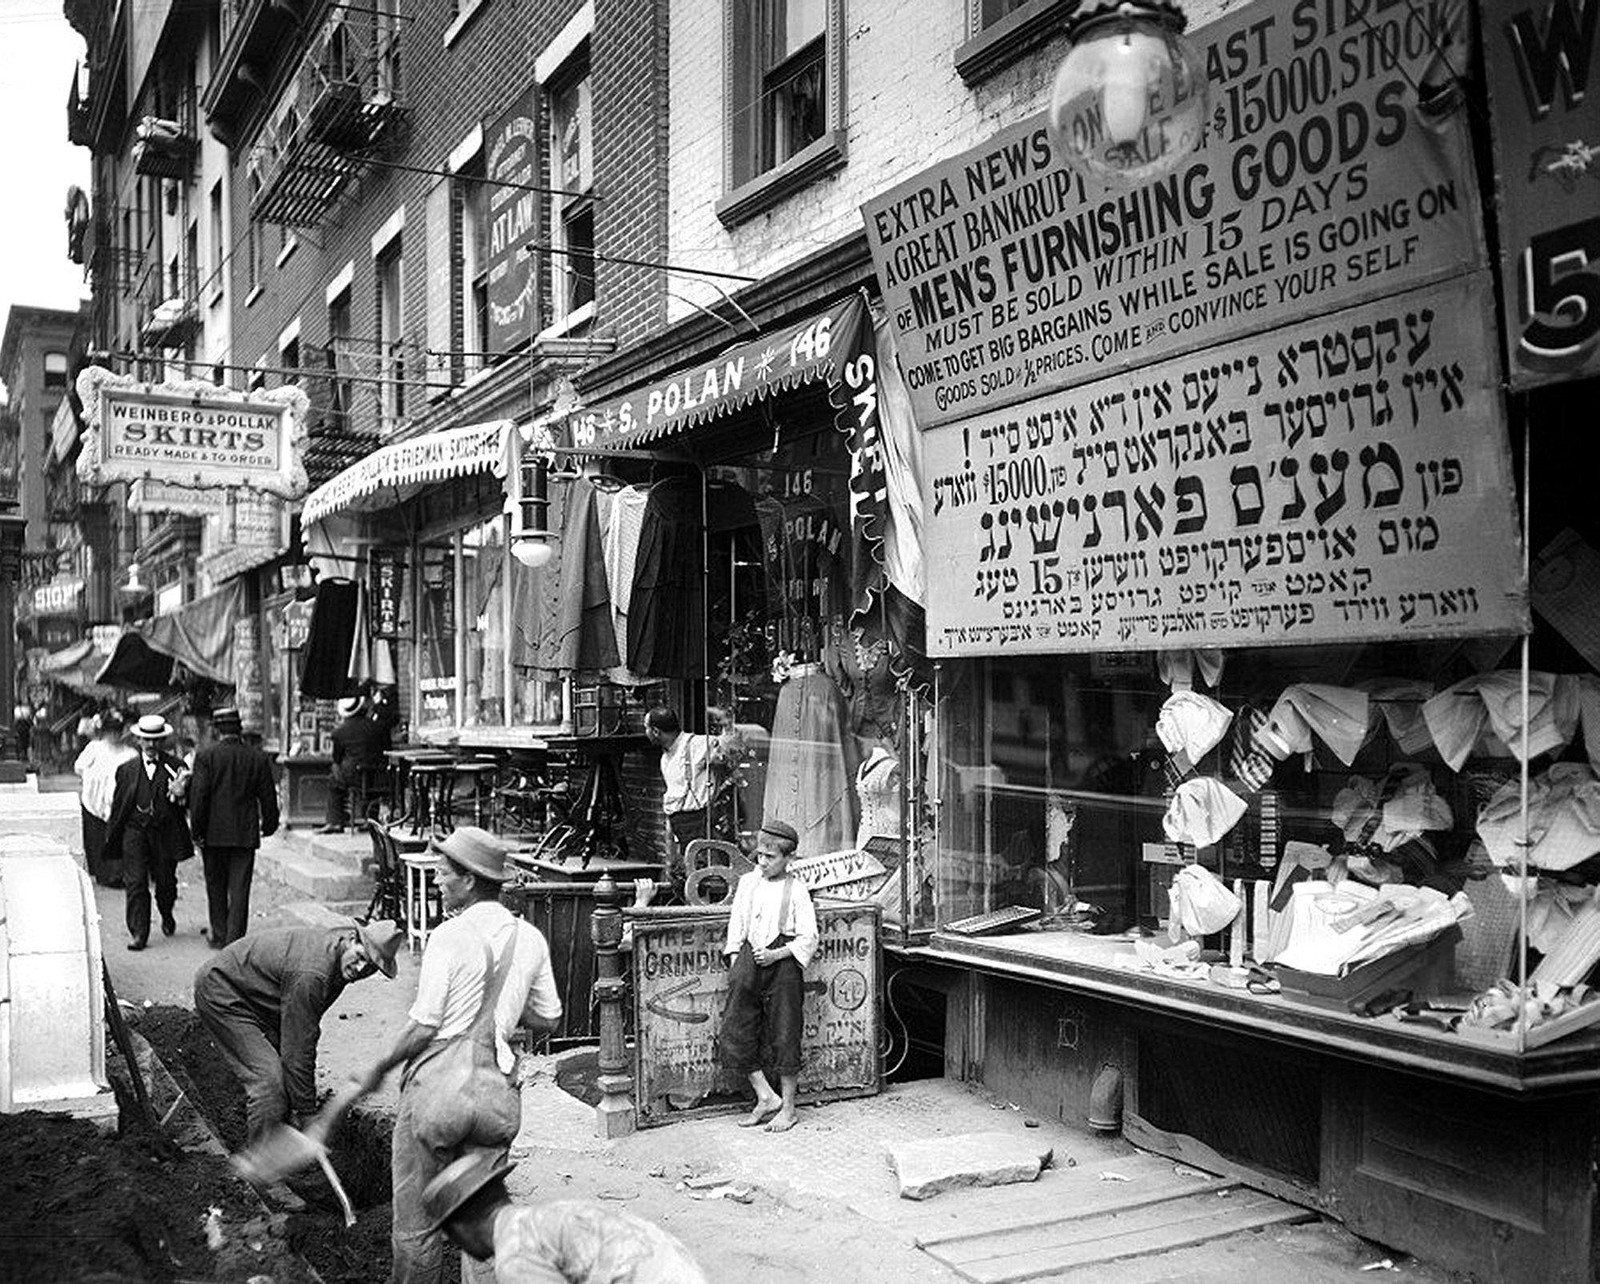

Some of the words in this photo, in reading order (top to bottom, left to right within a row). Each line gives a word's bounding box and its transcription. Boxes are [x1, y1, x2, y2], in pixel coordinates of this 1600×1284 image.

[874, 178, 959, 246] EXTRA
[965, 128, 1051, 202] NEWS
[1293, 0, 1398, 49] SID
[896, 308, 913, 331] OF
[910, 256, 997, 330] MEN'S
[1000, 164, 1215, 293] FURNISHING
[1232, 80, 1407, 201] GOODS
[885, 260, 897, 289] A
[894, 219, 959, 282] GREAT
[926, 311, 984, 353] MUST
[991, 297, 1019, 329] BE
[1025, 275, 1083, 316] SOLD
[1094, 231, 1188, 291] WITHIN
[1202, 209, 1244, 258] 15
[1260, 163, 1368, 233] DAYS
[908, 358, 944, 390] COME
[943, 353, 960, 378] TO
[960, 344, 985, 372] GET
[988, 334, 1015, 362] BIG
[1017, 300, 1113, 353] BARGAINS
[1118, 270, 1197, 317] WHILE
[1206, 243, 1275, 289] SALE
[1285, 231, 1311, 265] IS
[1319, 199, 1410, 253] GOING
[1417, 180, 1458, 221] ON
[935, 379, 977, 411] GOODS
[981, 367, 1014, 396] SOLD
[1036, 344, 1089, 376] PRICES.
[1091, 325, 1142, 362] COME
[1168, 284, 1268, 334] CONVINCE
[1274, 262, 1337, 304] YOUR
[1347, 235, 1420, 281] SELF
[1278, 308, 1434, 388] עקסטרא
[618, 402, 637, 433] S.
[647, 356, 744, 425] POLAN
[790, 317, 832, 367] 146
[1402, 361, 1464, 428] איין
[113, 405, 204, 425] WEINBERG
[208, 414, 215, 426] &
[217, 415, 275, 430] POLLAK
[1026, 404, 1077, 450] איסט
[1132, 379, 1172, 433] אין
[1264, 378, 1394, 450] גרויסער
[114, 445, 159, 457] READY
[164, 448, 197, 460] MADE
[212, 453, 227, 463] TO
[230, 454, 272, 466] ORDER
[123, 422, 264, 452] SKIRTS
[1072, 440, 1119, 485] סייל
[785, 469, 812, 497] 146
[1415, 458, 1462, 511] פון
[1378, 516, 1440, 555] מוס
[380, 566, 394, 633] SKIRTS
[974, 567, 1019, 601] טעג
[1029, 557, 1063, 595] 15
[1285, 567, 1372, 597] קאמט
[1398, 587, 1479, 624] ווארע
[645, 949, 732, 978] GRINDIN
[812, 937, 869, 961] SHING
